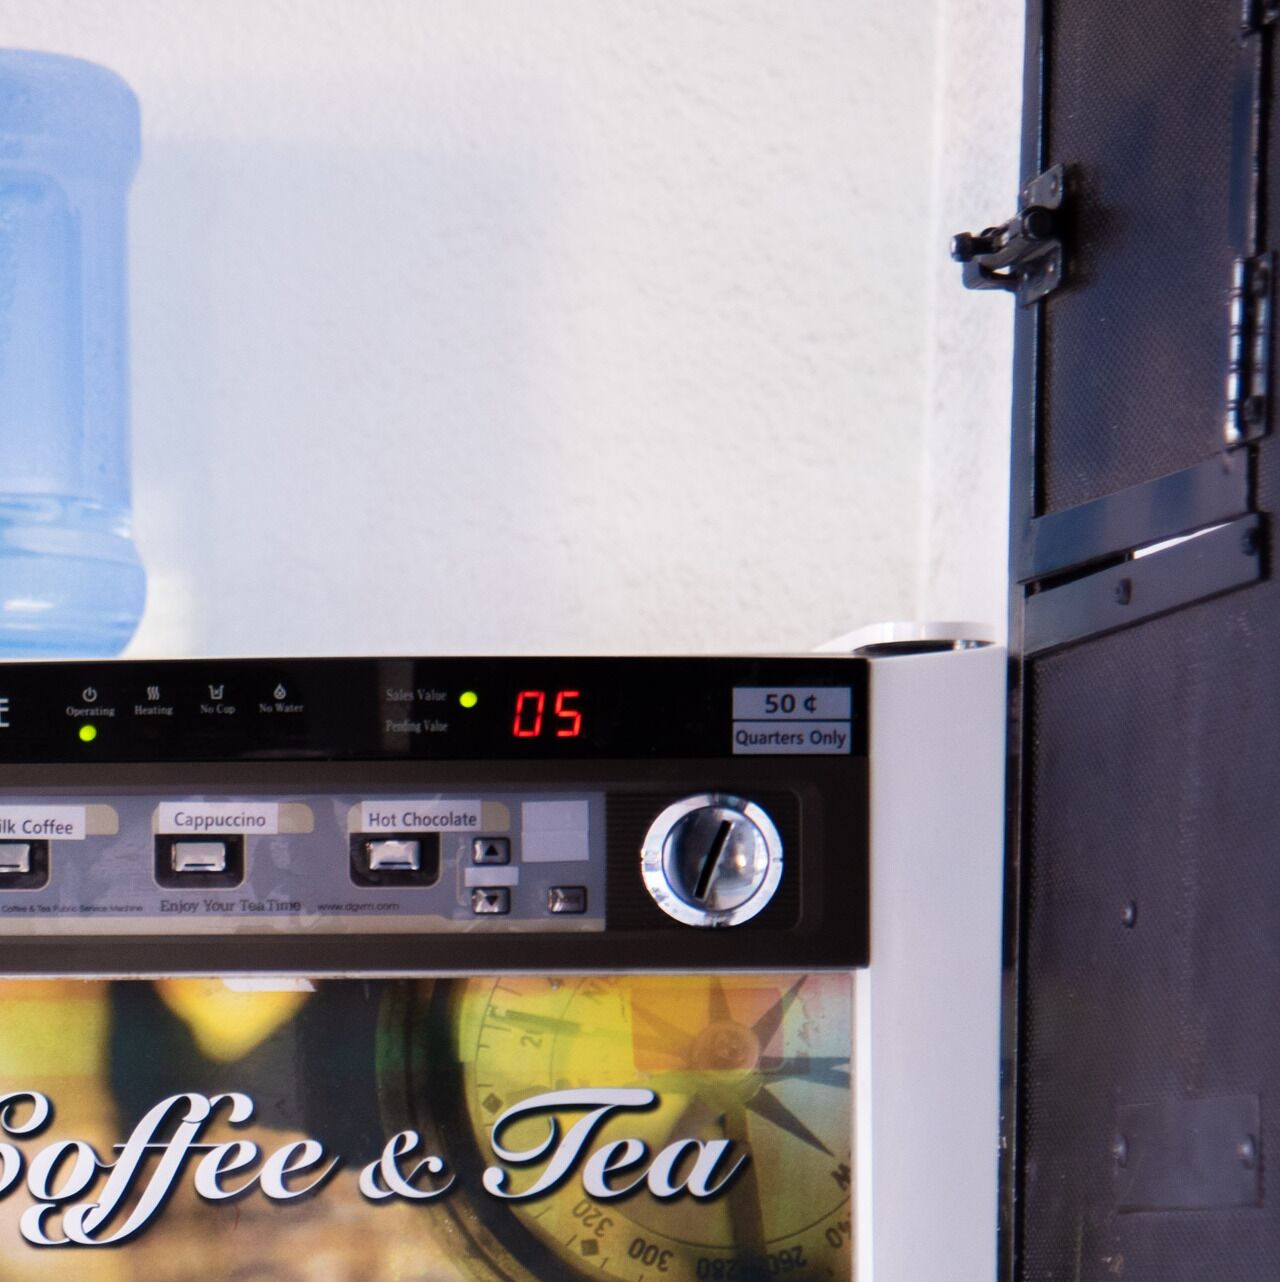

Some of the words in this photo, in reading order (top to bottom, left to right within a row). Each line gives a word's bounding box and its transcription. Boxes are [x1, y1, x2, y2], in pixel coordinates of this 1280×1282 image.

[66, 705, 115, 717] Operating
[134, 705, 173, 716] Heating
[200, 704, 214, 714] No
[216, 704, 236, 715] Cup
[259, 703, 273, 713] No
[275, 703, 304, 713] Water
[763, 692, 797, 715] 50
[803, 693, 817, 715] ¢
[512, 690, 582, 738] 05
[735, 729, 805, 747] Quarters
[809, 728, 847, 749] Only
[22, 818, 74, 835] Coffee
[174, 811, 267, 831] Cappuccino
[369, 811, 396, 827] Hot
[400, 811, 477, 828] Chocolate
[160, 900, 199, 914] Enjoy
[203, 900, 234, 912] Your
[358, 1130, 455, 1199] &
[482, 1087, 748, 1199] Tea
[627, 1236, 674, 1273] 300
